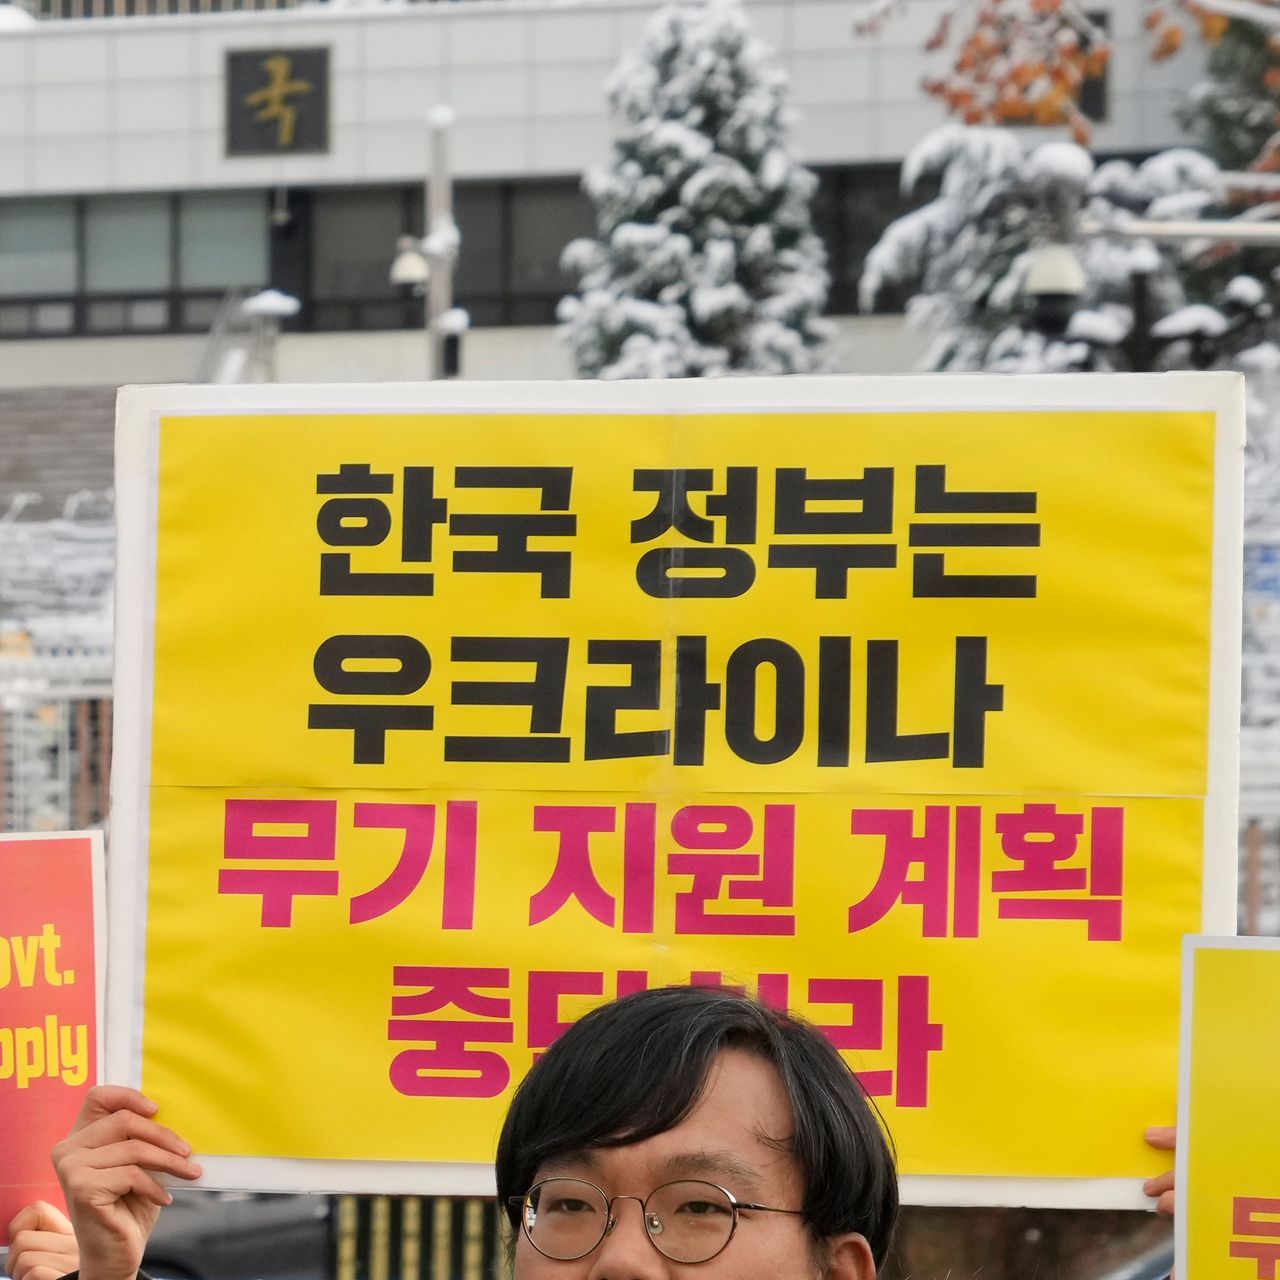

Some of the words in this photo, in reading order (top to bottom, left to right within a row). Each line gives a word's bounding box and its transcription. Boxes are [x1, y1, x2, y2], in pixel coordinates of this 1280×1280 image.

[243, 55, 314, 145] 국
[317, 464, 576, 598] 한국
[631, 465, 1040, 599] 정부는
[308, 635, 1003, 768] 우크라이나
[218, 799, 478, 930] 무기
[529, 802, 797, 936] 지원
[848, 803, 1125, 942] 계획
[387, 965, 944, 1108] 중라
